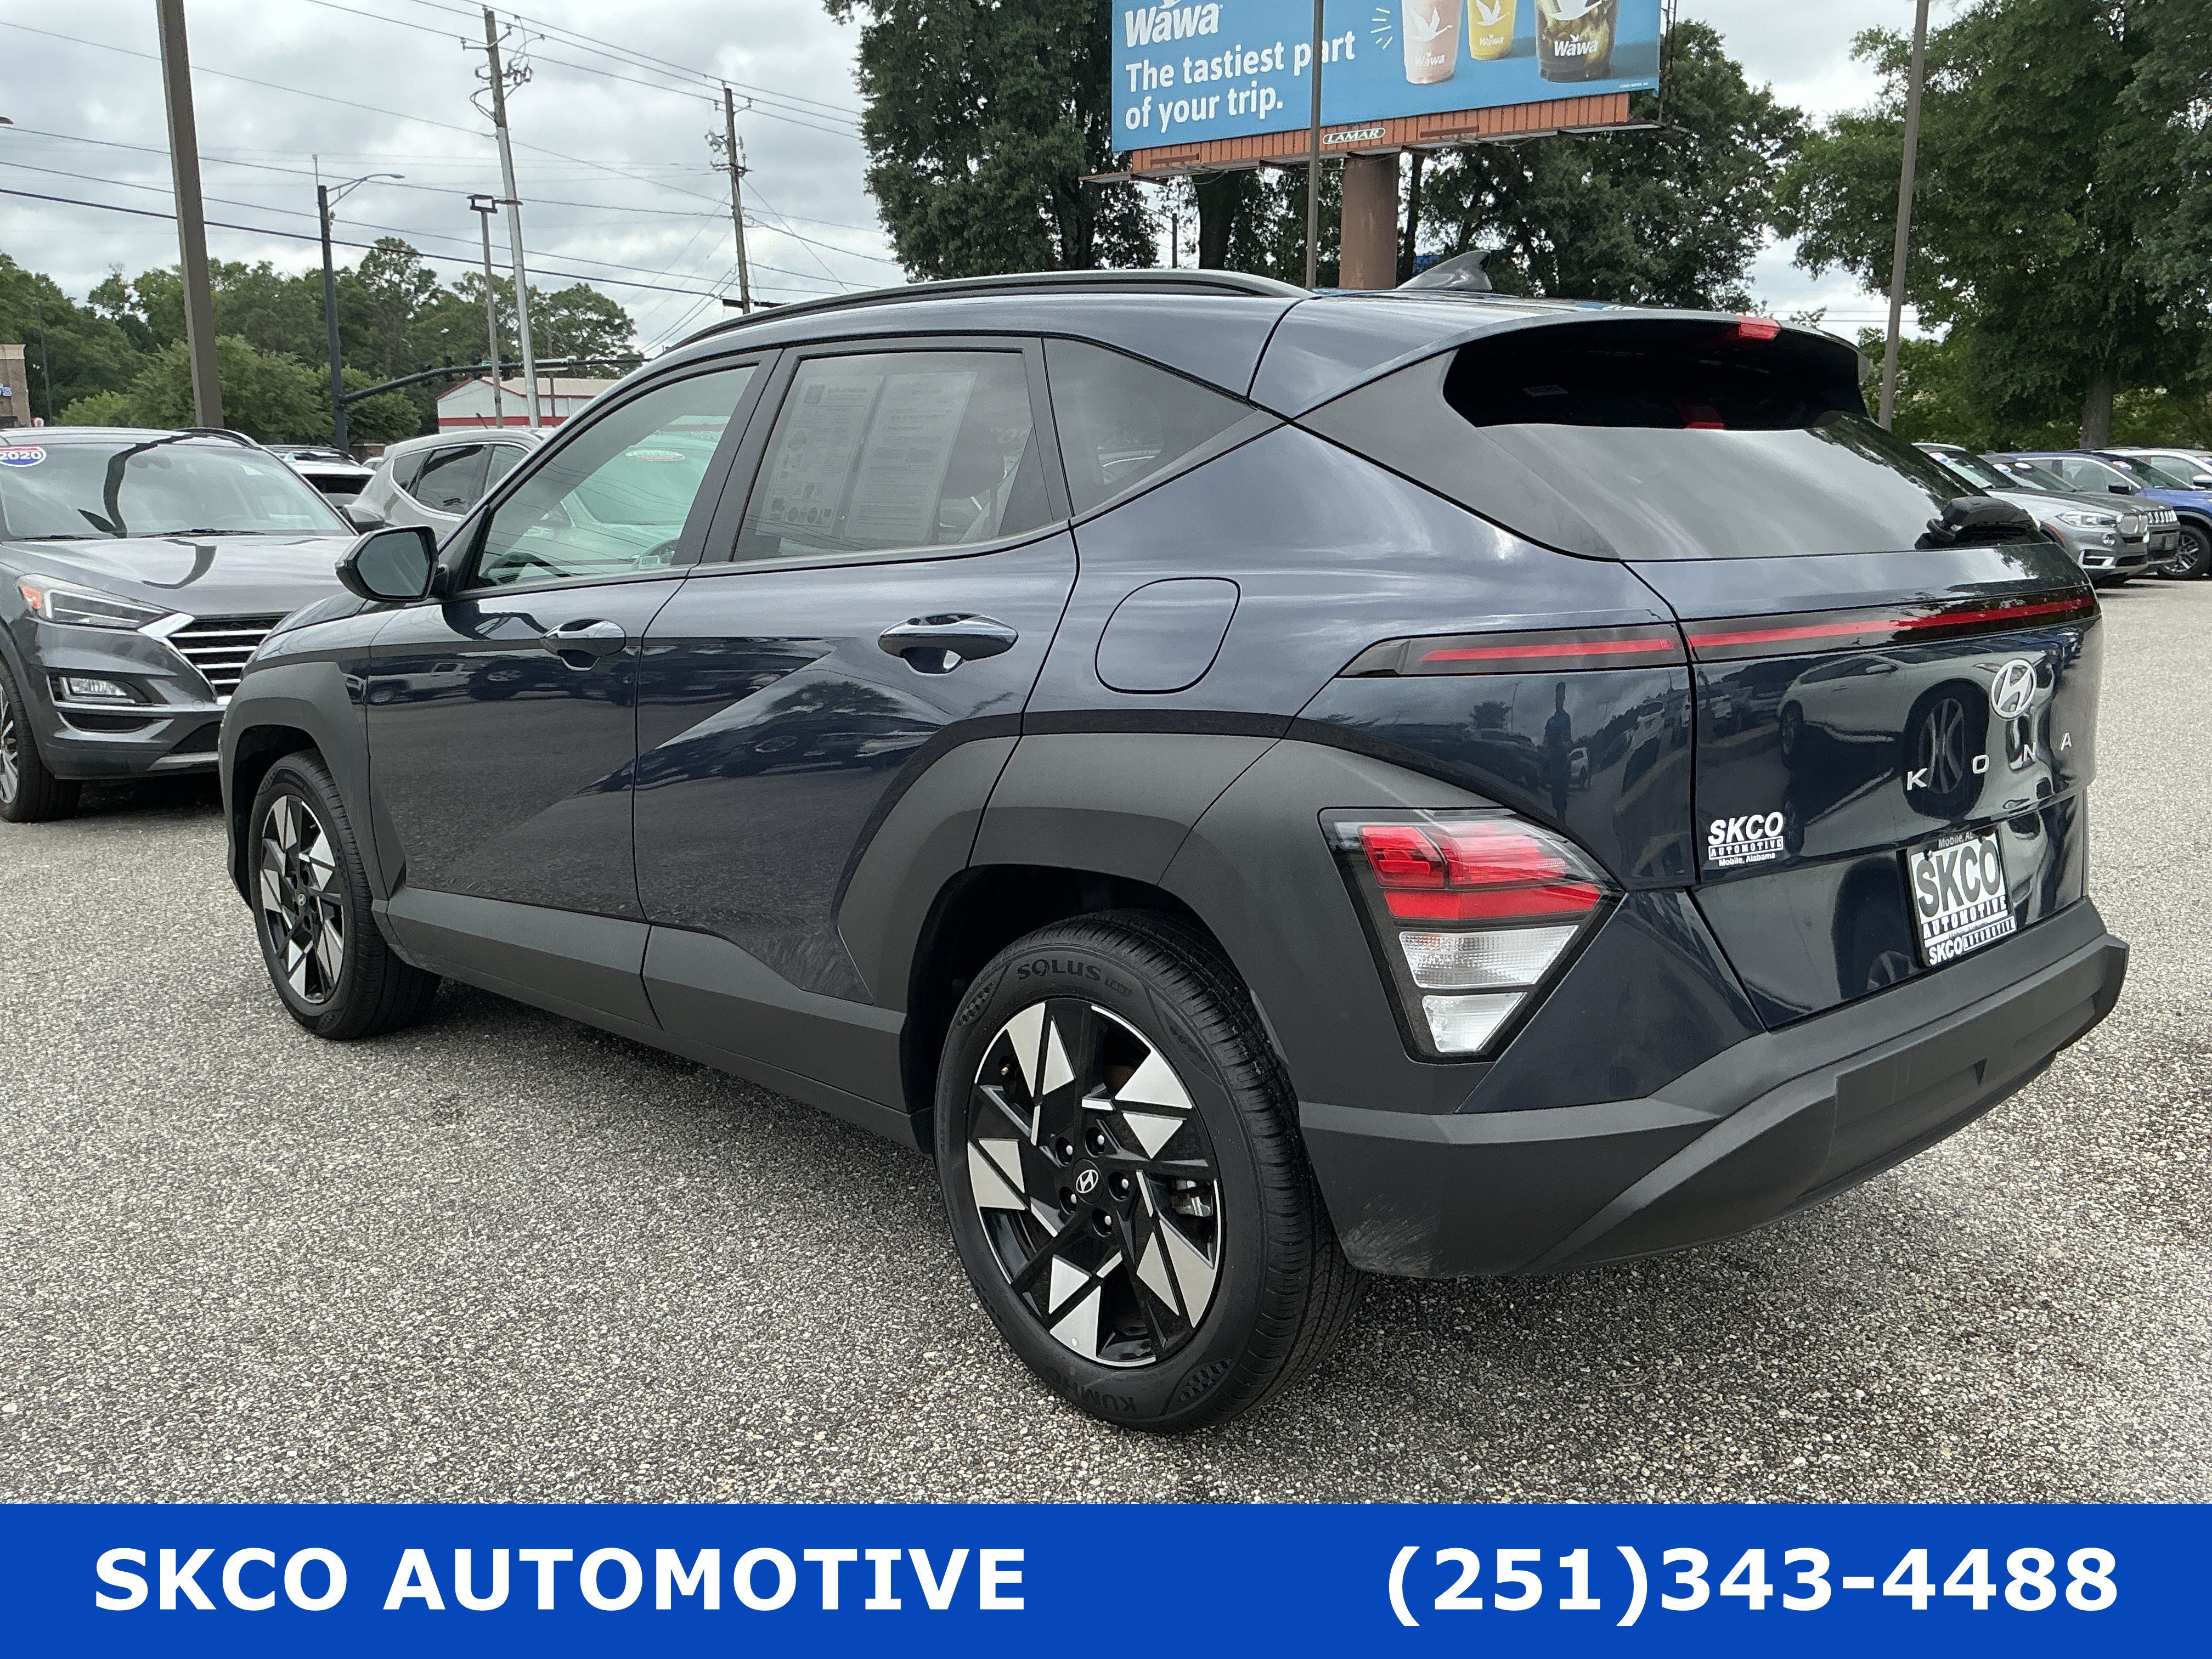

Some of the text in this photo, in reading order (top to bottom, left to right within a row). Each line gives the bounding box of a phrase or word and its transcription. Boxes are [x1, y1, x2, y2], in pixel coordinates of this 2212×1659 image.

[1125, 3, 1218, 48] Wawa
[1479, 36, 1504, 47] Wawa
[1554, 38, 1599, 57] Wawa
[1125, 59, 1174, 92] The
[1183, 41, 1284, 84] tastiest
[1414, 54, 1445, 67] Wawa
[1125, 80, 1283, 133] of your trip.
[1328, 129, 1379, 143] LAMAR
[0, 452, 42, 460] 2020
[1707, 811, 1783, 845] SKCO
[1711, 839, 1782, 857] AUTOMOTIVE
[1938, 832, 1974, 849] Mobile, AL
[1746, 852, 1775, 863] Alabama
[1916, 840, 2001, 918] SKCO
[1923, 895, 2008, 940] AUTOMOTIVE
[1929, 936, 1963, 966] SKCO
[1017, 958, 1102, 981] SOLUS
[1045, 1367, 1137, 1413] KUMHO
